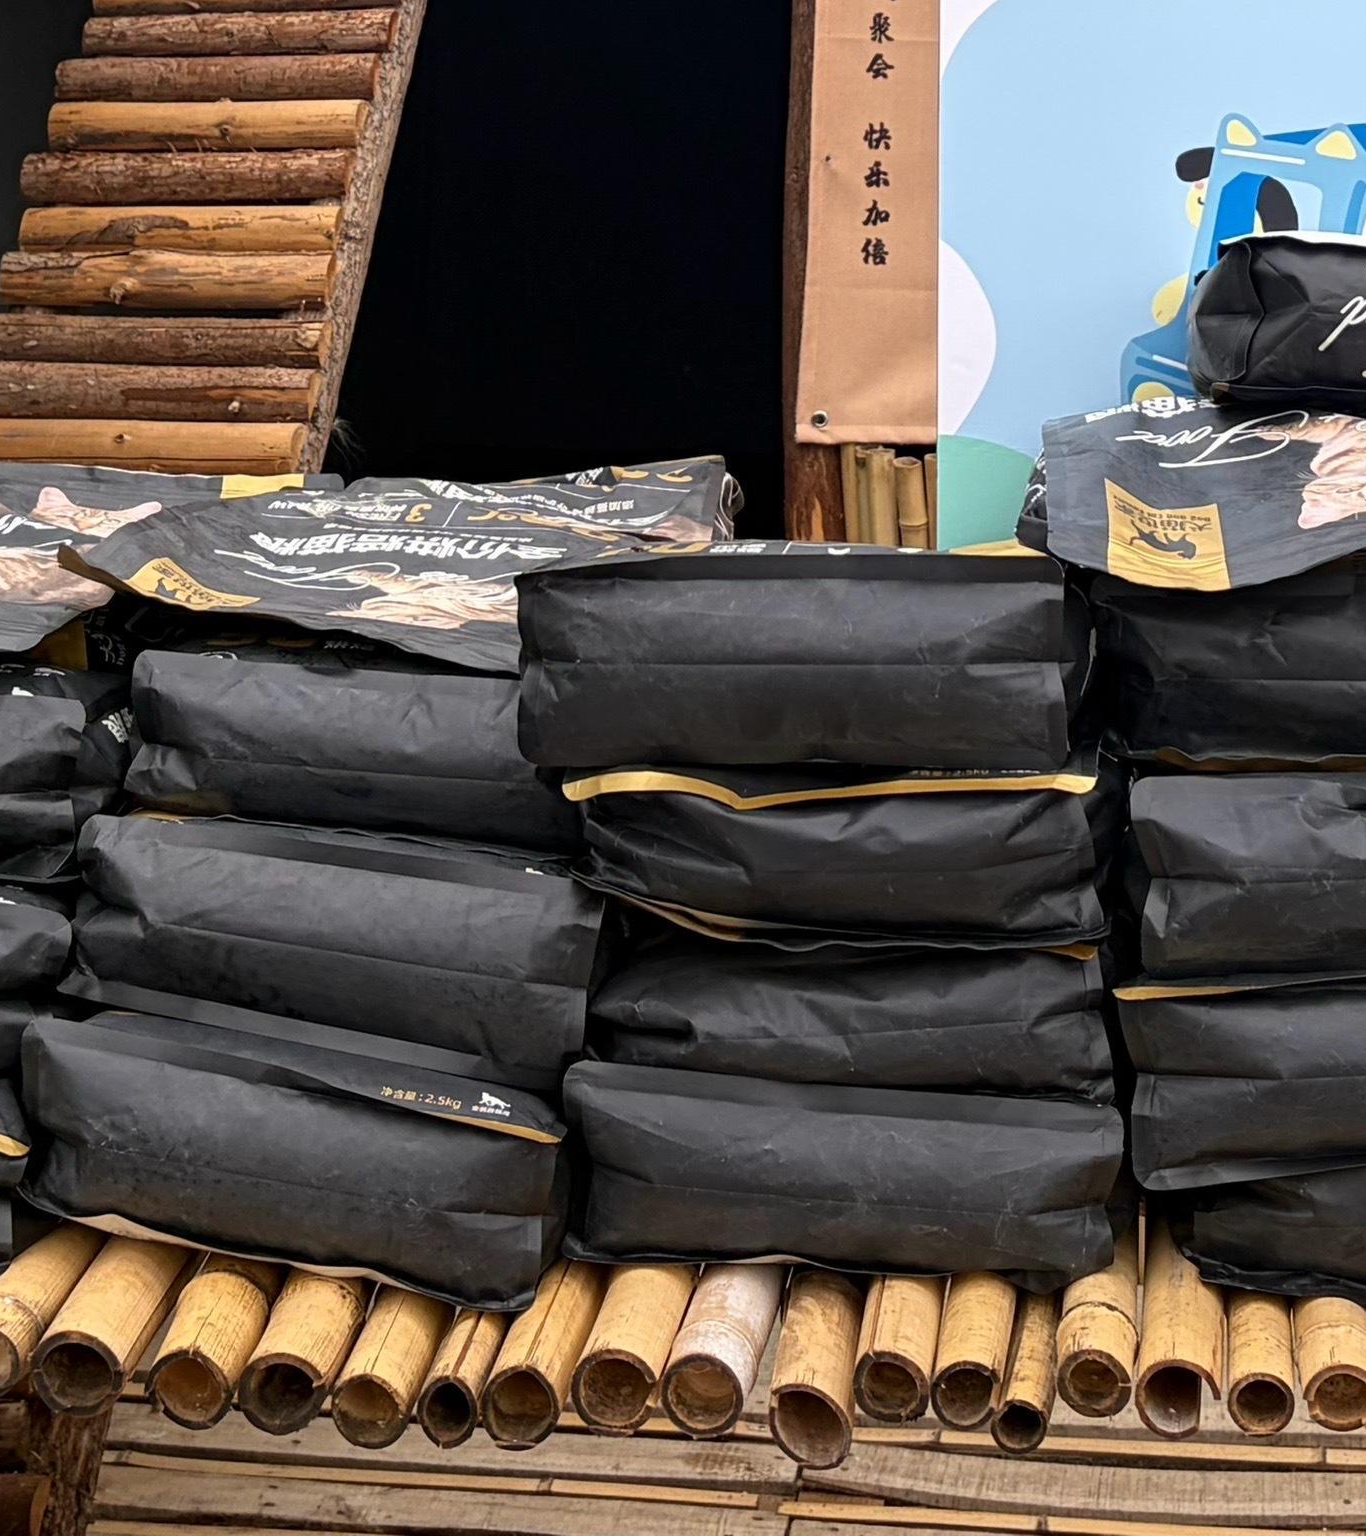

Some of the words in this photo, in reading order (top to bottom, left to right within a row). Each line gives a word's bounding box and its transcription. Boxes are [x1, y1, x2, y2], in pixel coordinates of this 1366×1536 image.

[860, 121, 893, 266] 快乐加倍
[379, 1085, 463, 1111] 净含量：2.5kg
